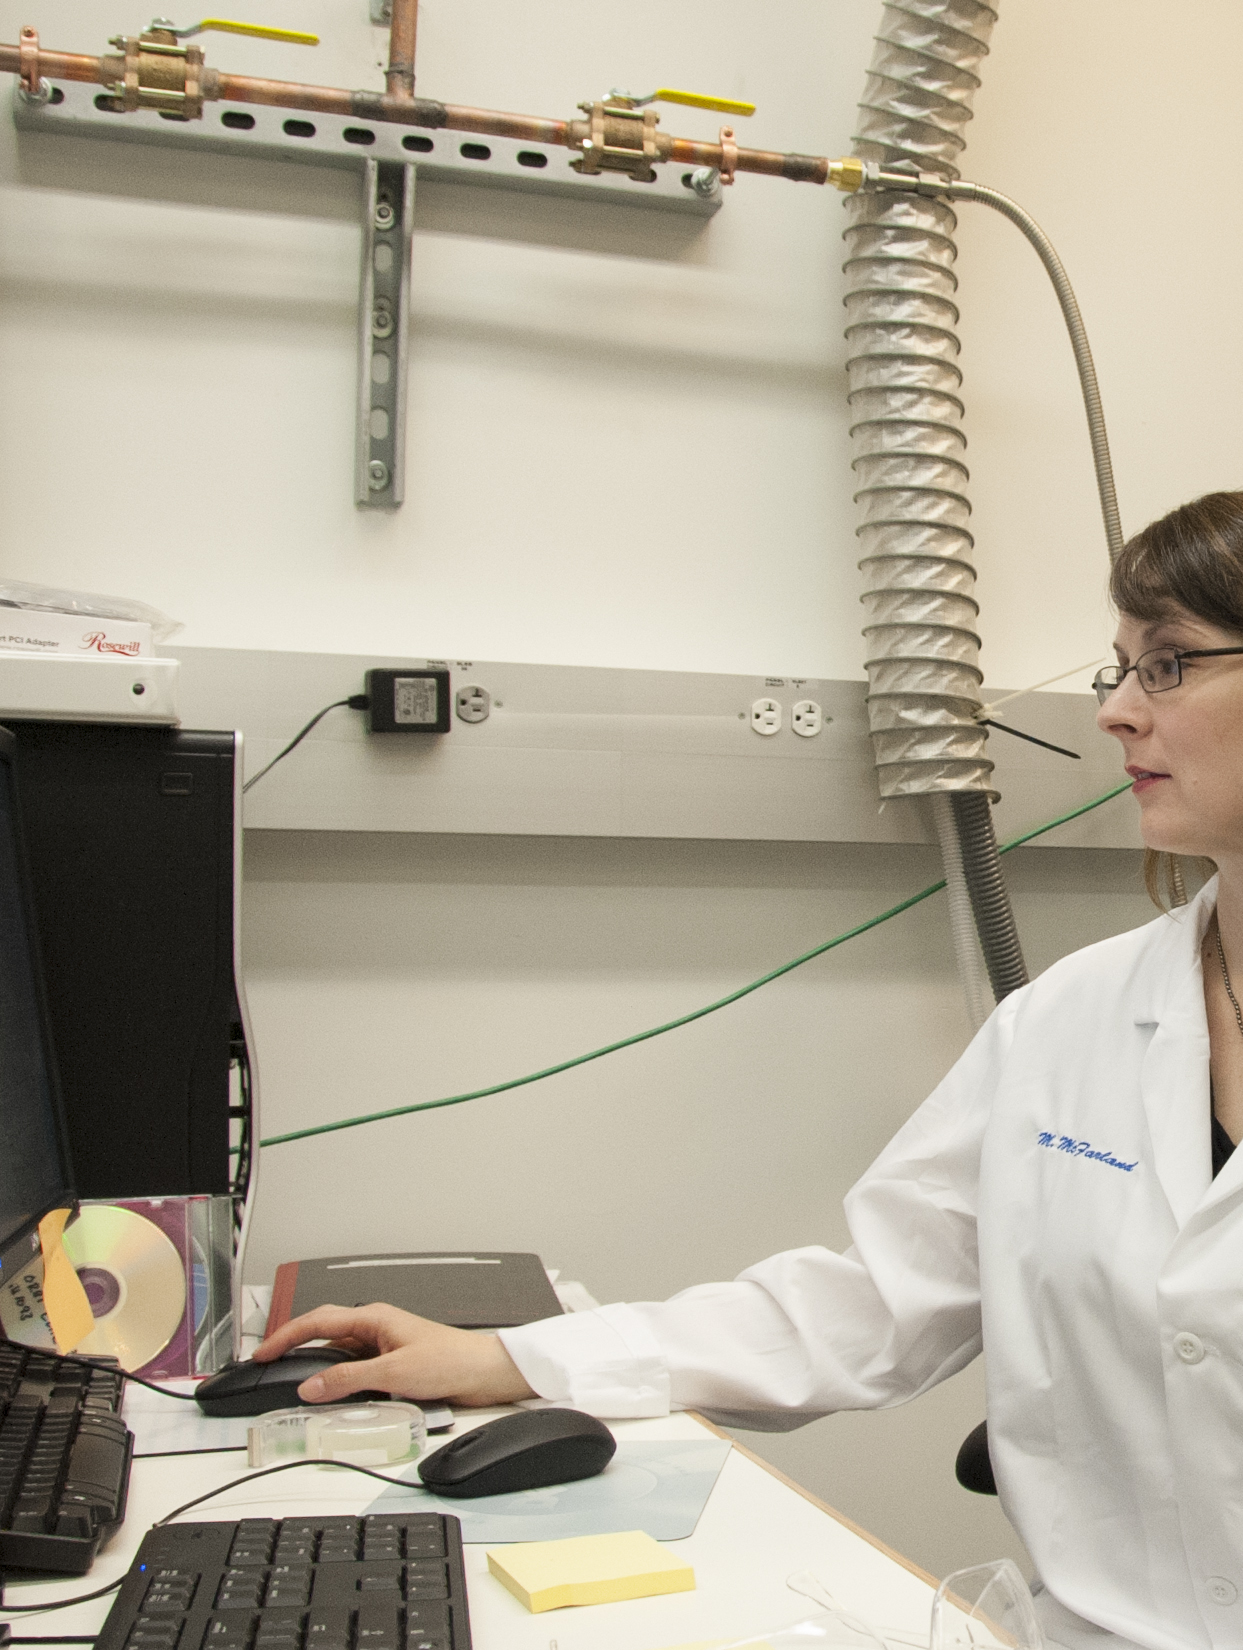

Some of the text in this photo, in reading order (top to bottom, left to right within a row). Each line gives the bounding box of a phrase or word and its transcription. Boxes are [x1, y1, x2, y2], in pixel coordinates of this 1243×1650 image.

[26, 637, 60, 648] Adapter
[78, 631, 140, 657] Rosewill
[1037, 1131, 1139, 1172] M. McFarland
